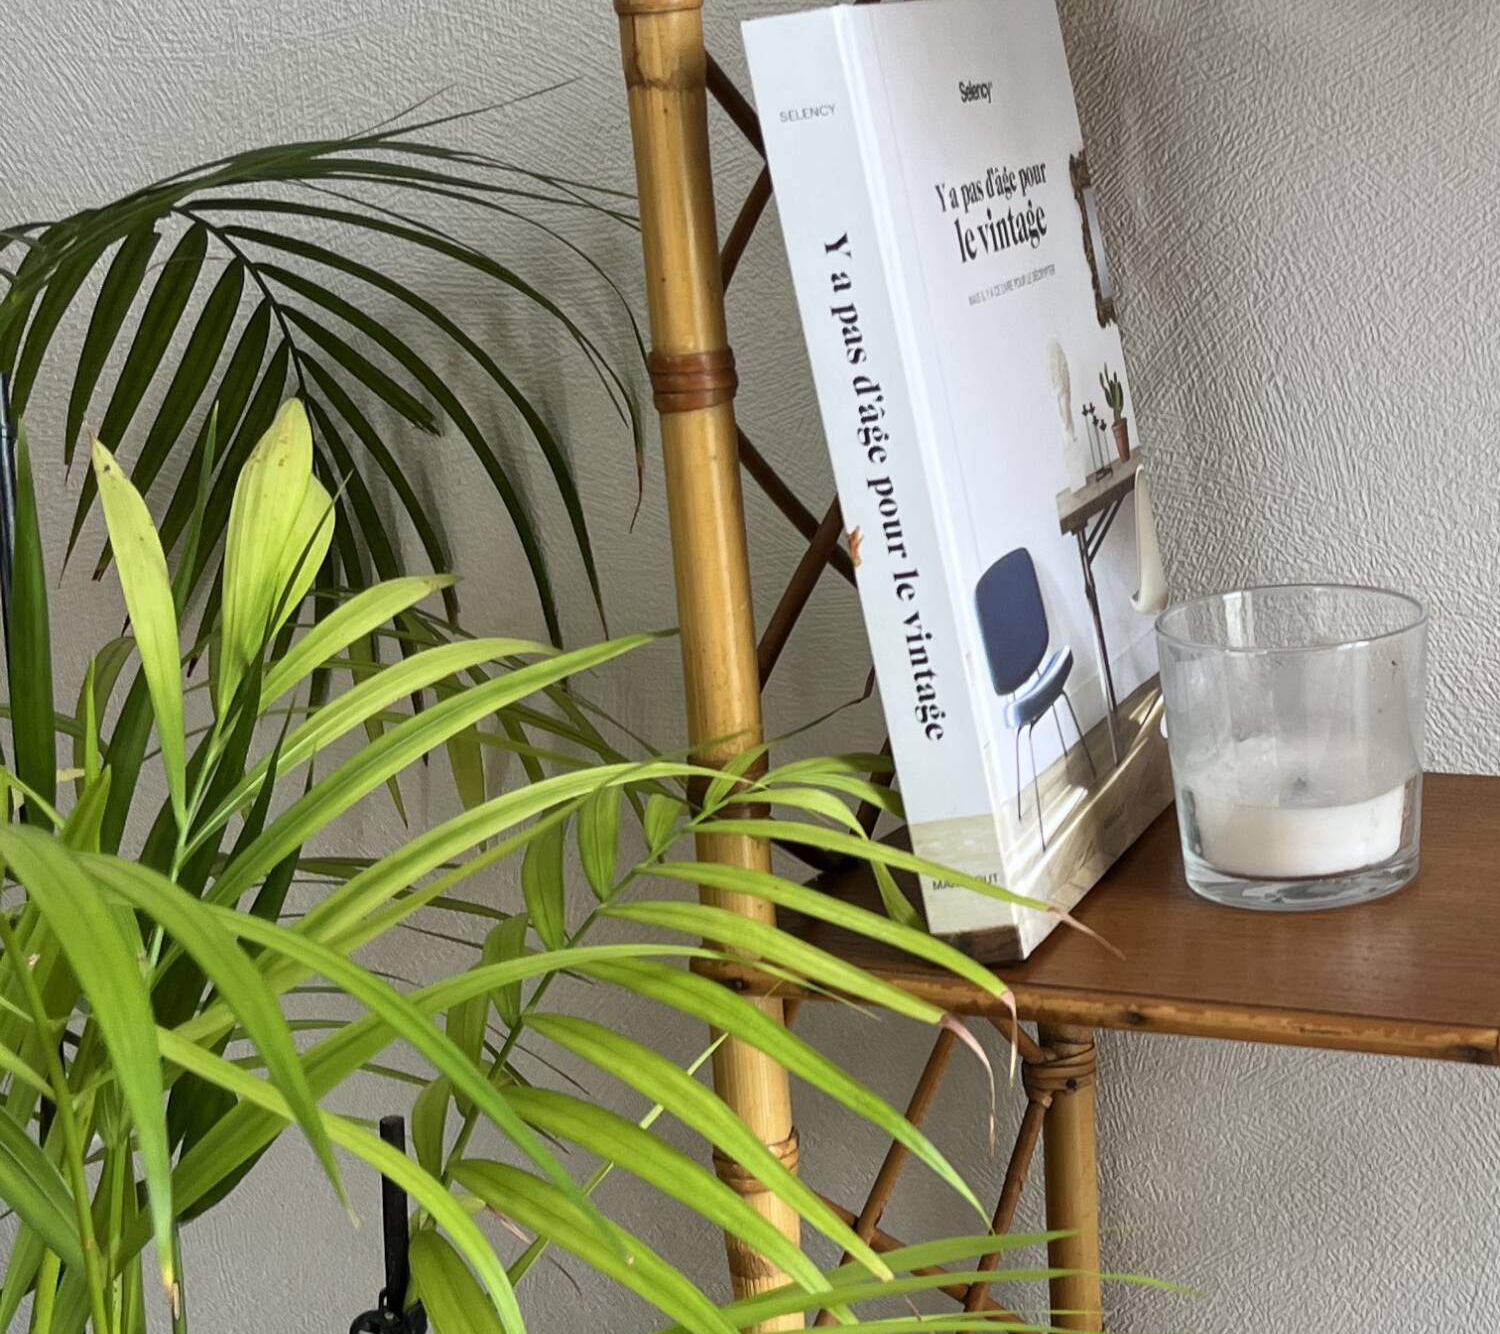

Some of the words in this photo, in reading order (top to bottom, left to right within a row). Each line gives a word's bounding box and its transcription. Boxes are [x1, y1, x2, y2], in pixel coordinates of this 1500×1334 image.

[779, 104, 836, 123] SELENCY
[958, 80, 992, 104] Selency
[934, 183, 946, 213] Y
[948, 187, 960, 209] a
[960, 180, 984, 214] pas
[985, 166, 1017, 200] d'âge
[1018, 163, 1046, 197] pour
[824, 232, 852, 259] Y
[954, 217, 977, 263] le
[977, 199, 1047, 255] vintage
[830, 271, 852, 293] a
[830, 303, 867, 365] pas
[852, 375, 889, 464] d'âge
[866, 476, 907, 559] pour
[893, 568, 919, 602] le
[903, 610, 946, 741] vintage
